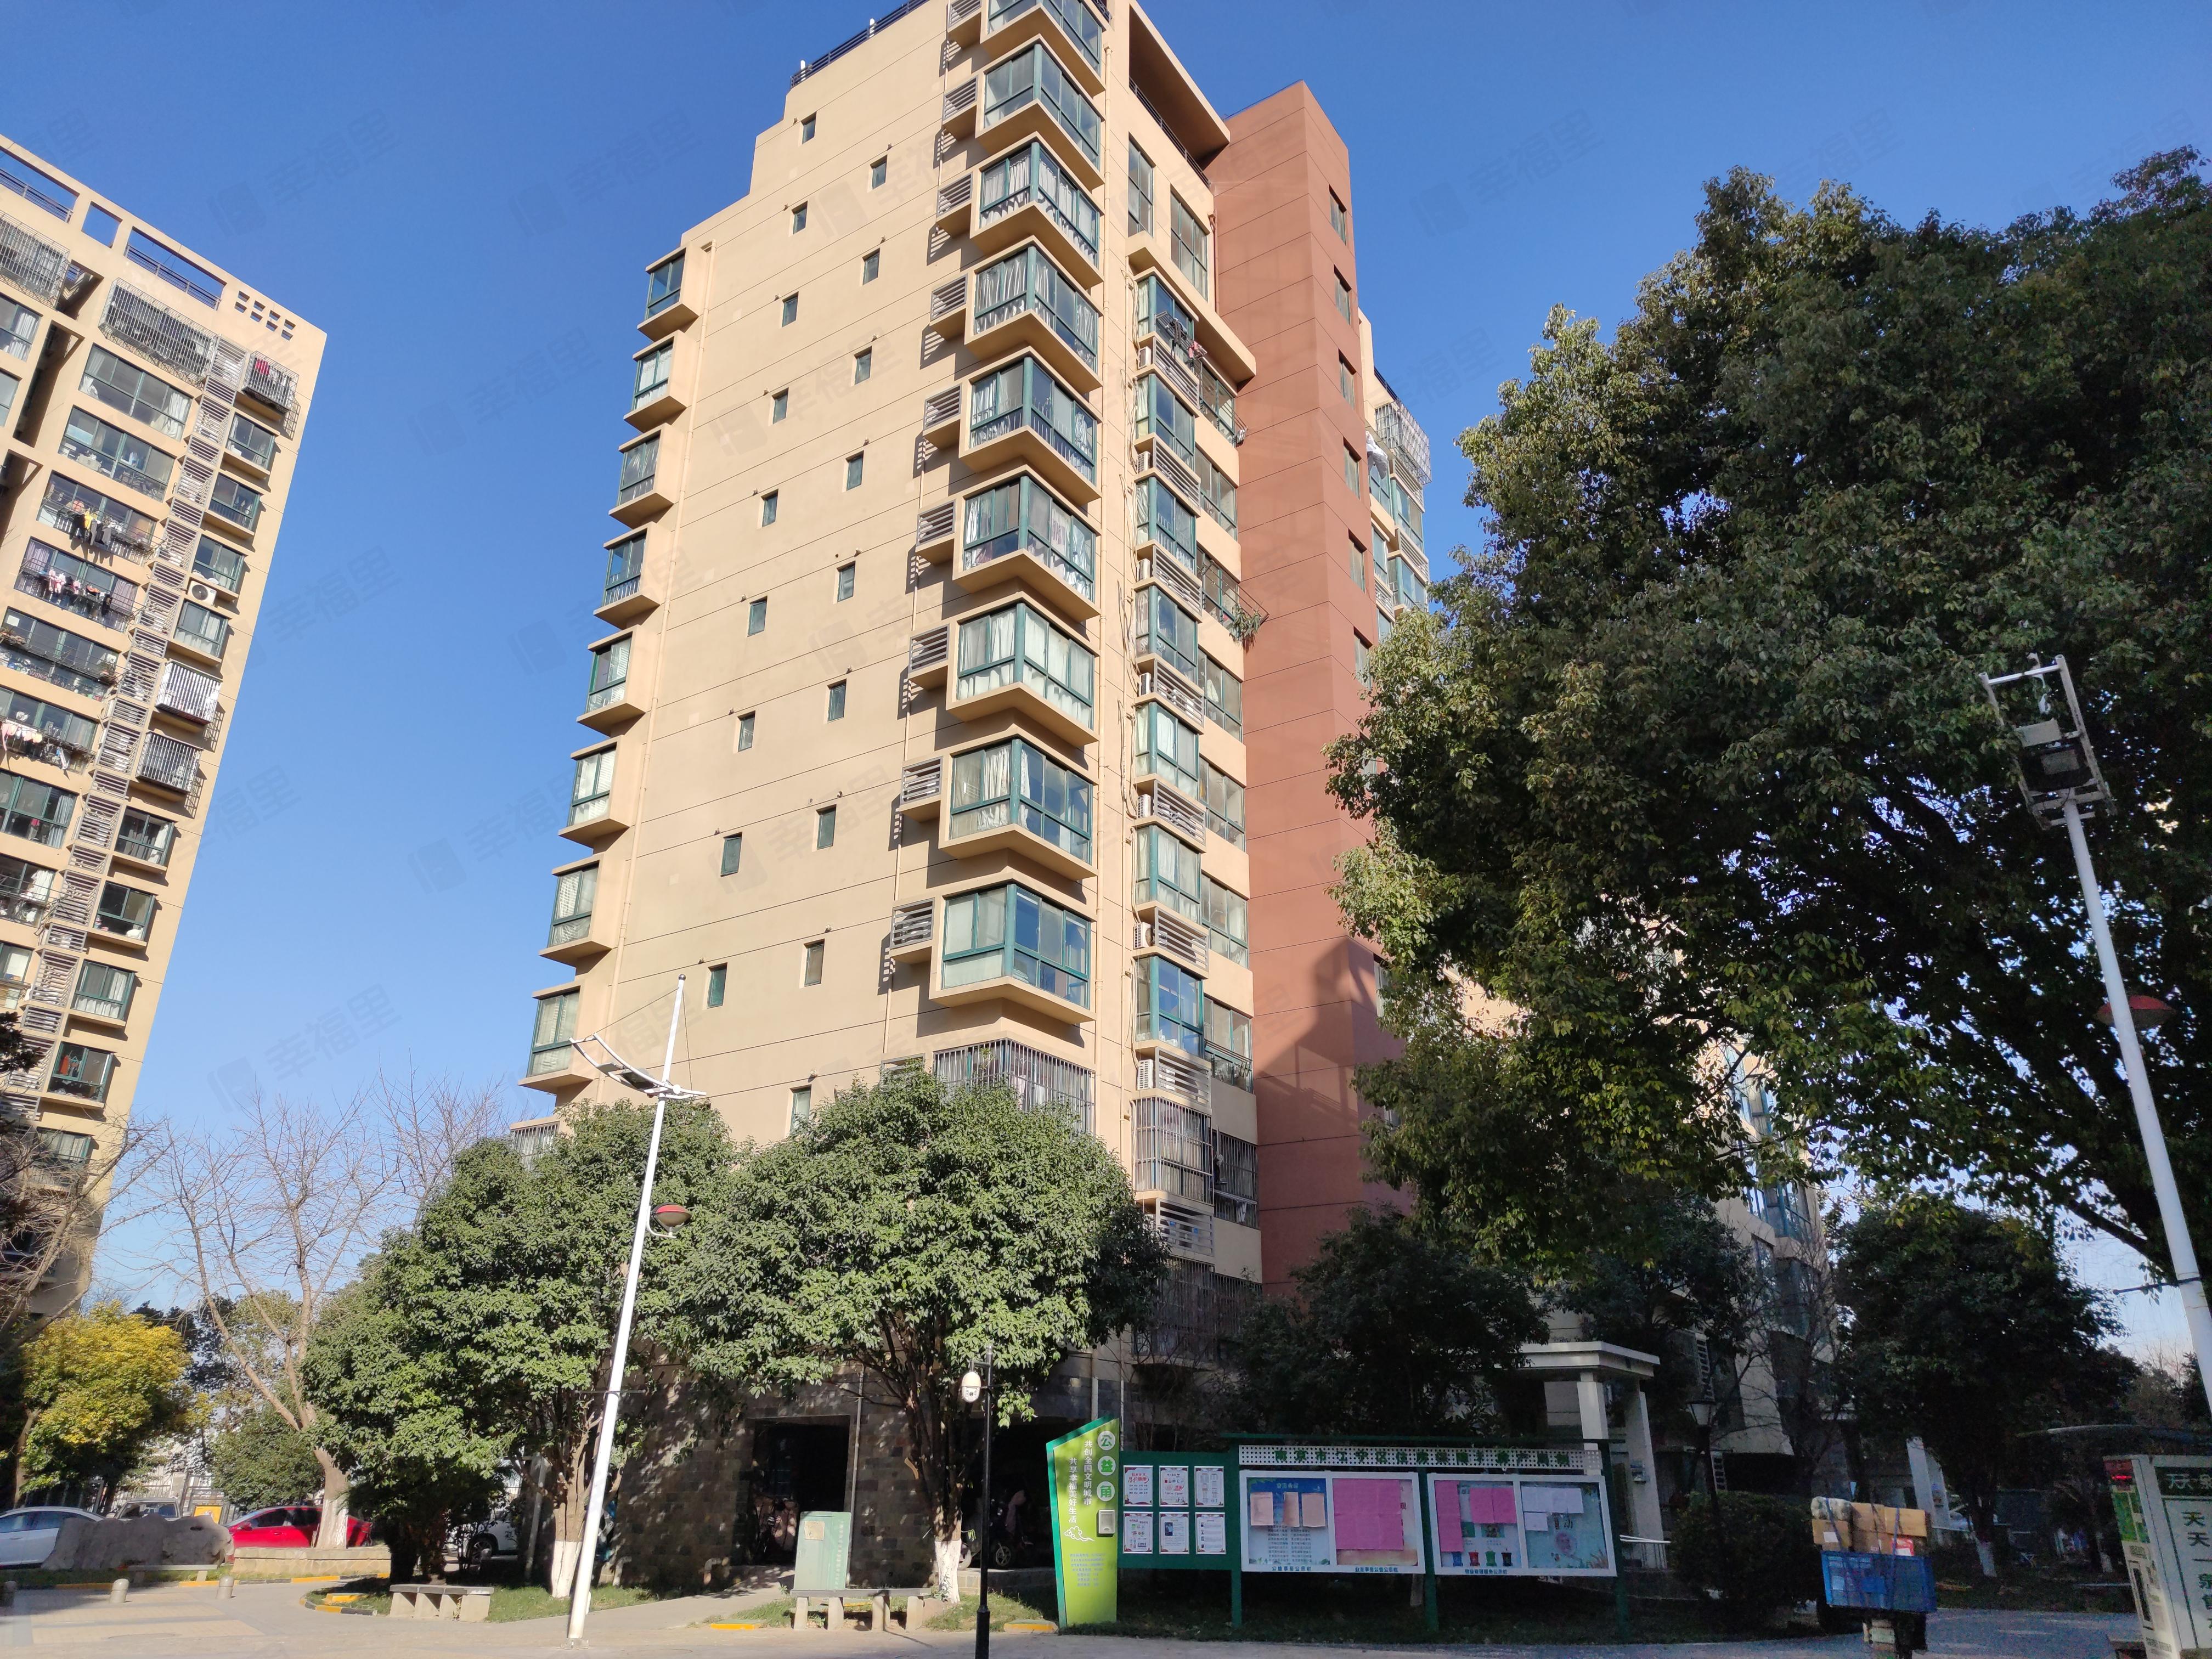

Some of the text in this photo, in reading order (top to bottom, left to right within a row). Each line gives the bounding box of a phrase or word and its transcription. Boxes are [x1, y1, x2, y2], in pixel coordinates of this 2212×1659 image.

[1068, 1458, 1078, 1523] 共享幸福美好生活
[1084, 1440, 1093, 1505] 共创全国文明城市
[1101, 1434, 1113, 1498] 公益角
